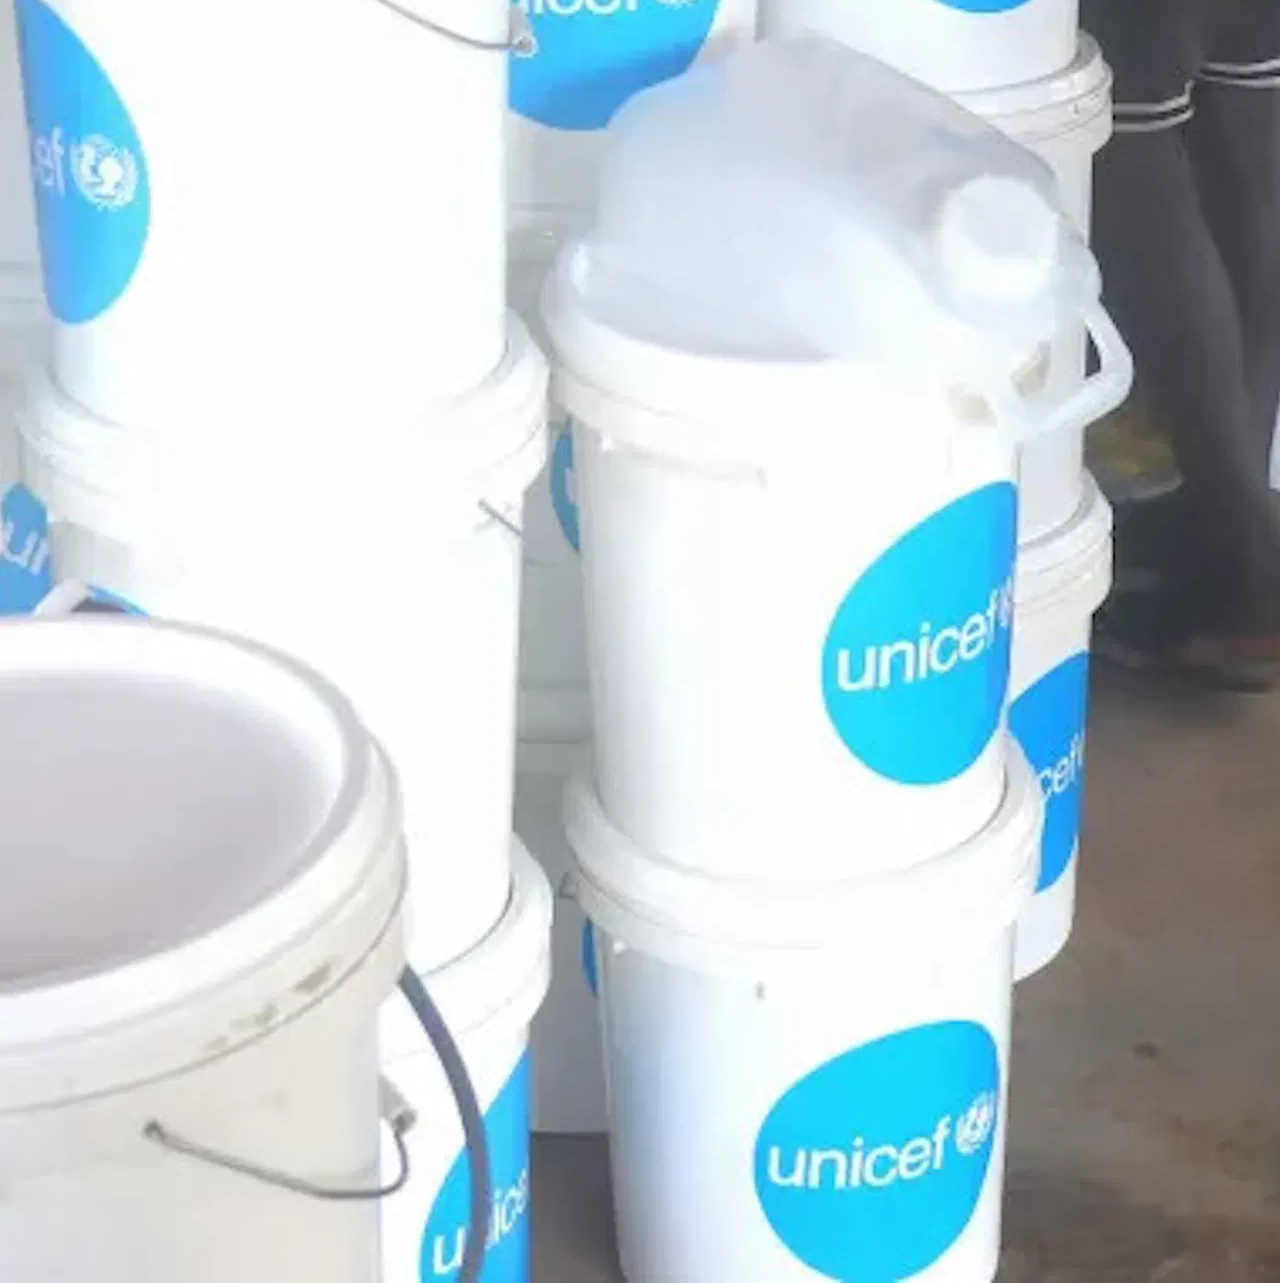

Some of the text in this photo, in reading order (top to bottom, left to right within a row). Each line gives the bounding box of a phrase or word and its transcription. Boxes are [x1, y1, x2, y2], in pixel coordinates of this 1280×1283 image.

[836, 588, 998, 692] unicef
[1039, 731, 1080, 796] cef
[768, 1114, 952, 1189] unicef
